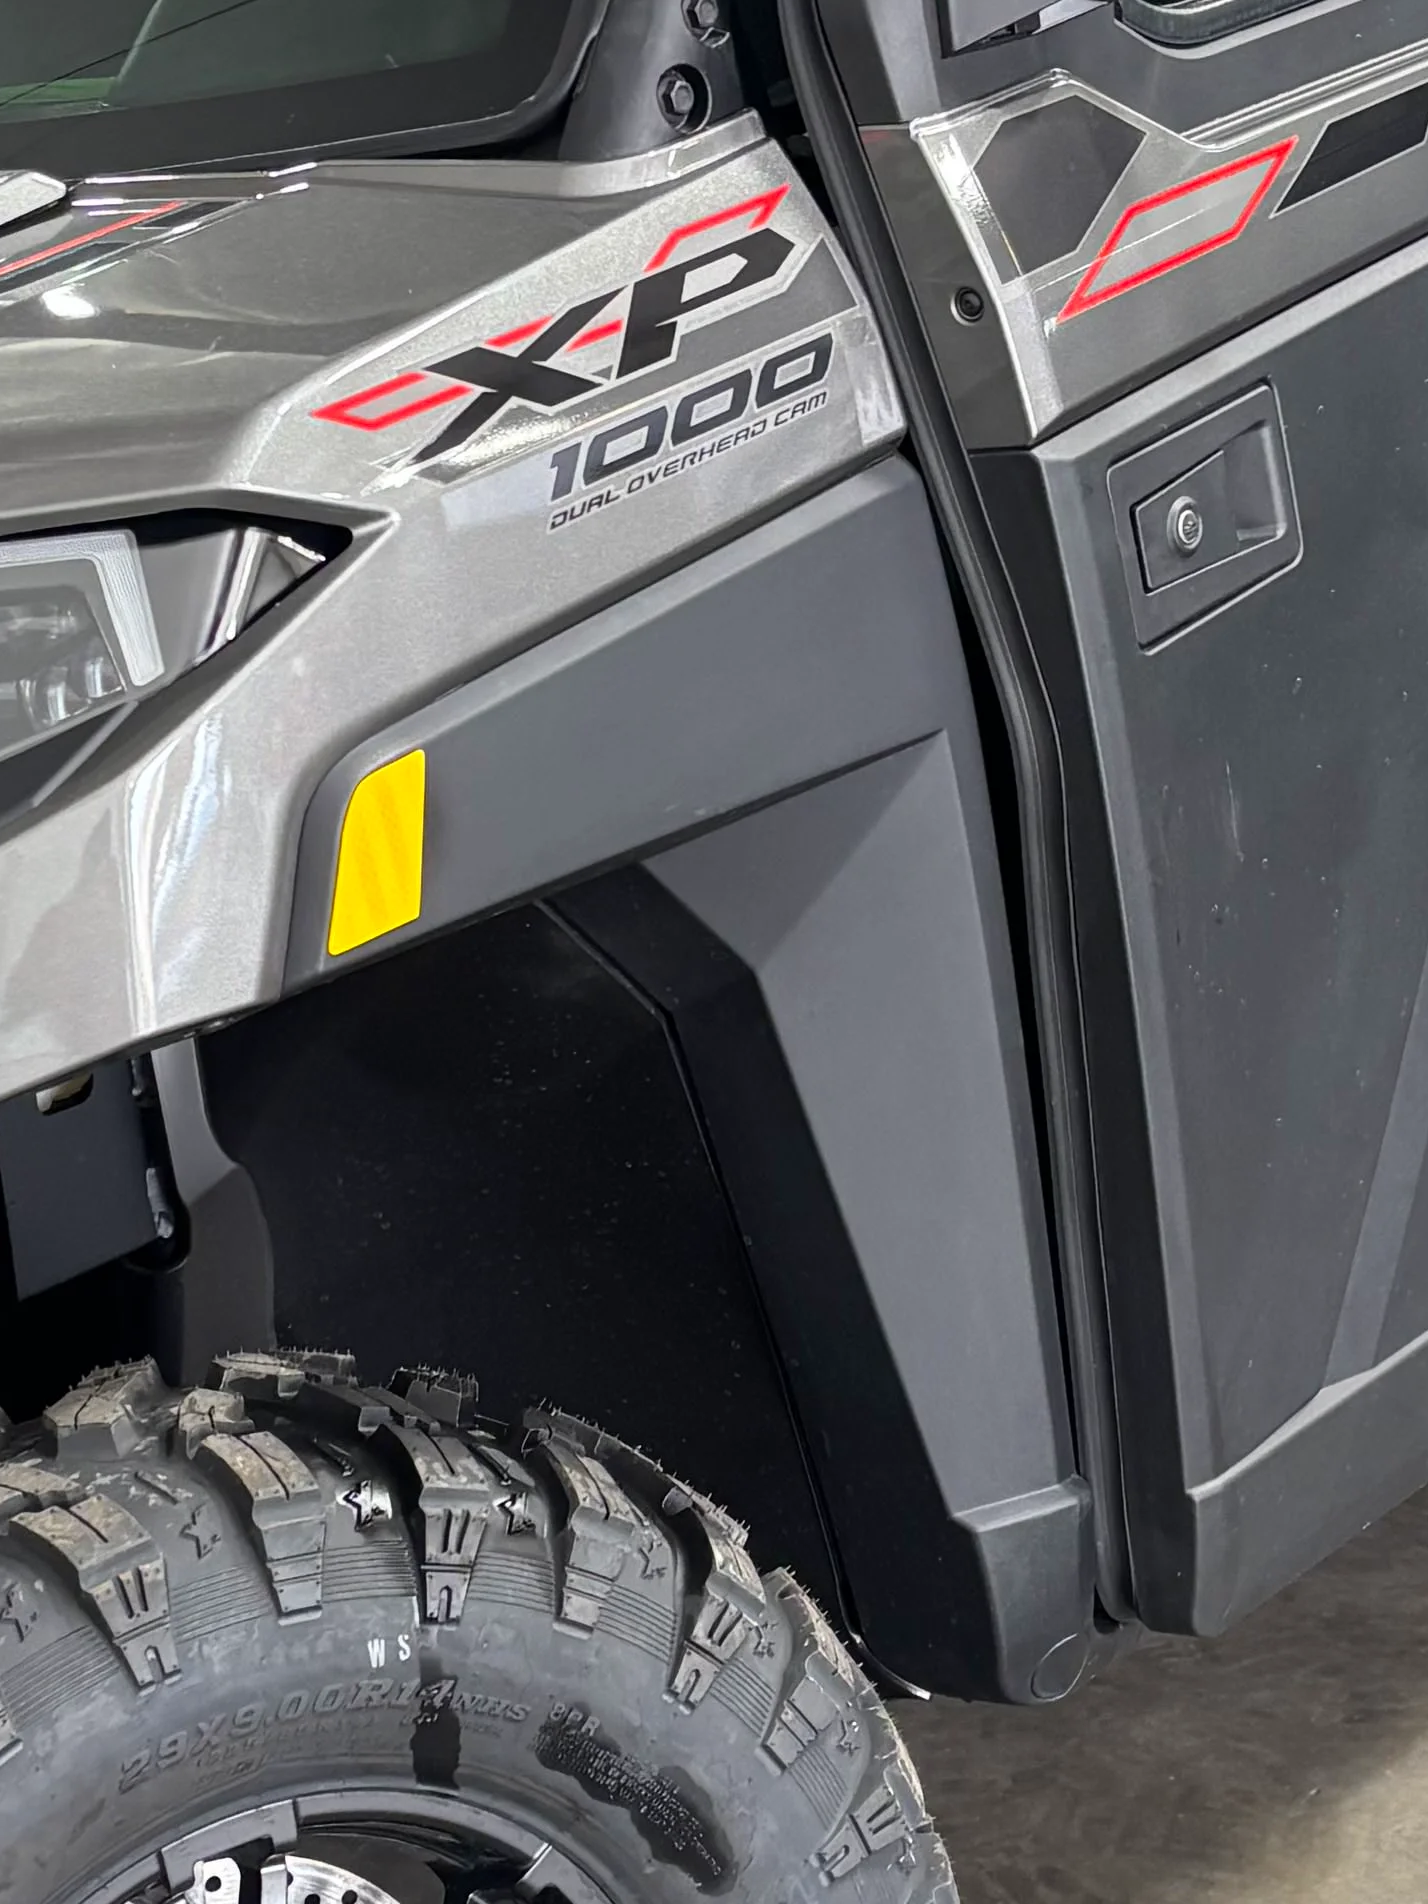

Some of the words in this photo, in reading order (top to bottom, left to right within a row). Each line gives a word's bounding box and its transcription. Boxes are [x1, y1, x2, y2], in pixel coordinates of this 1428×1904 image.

[409, 226, 798, 466] XP
[550, 332, 833, 502] 1000
[549, 488, 621, 531] DUAL
[626, 419, 767, 495] OVERHEAD
[773, 391, 828, 428] CAM
